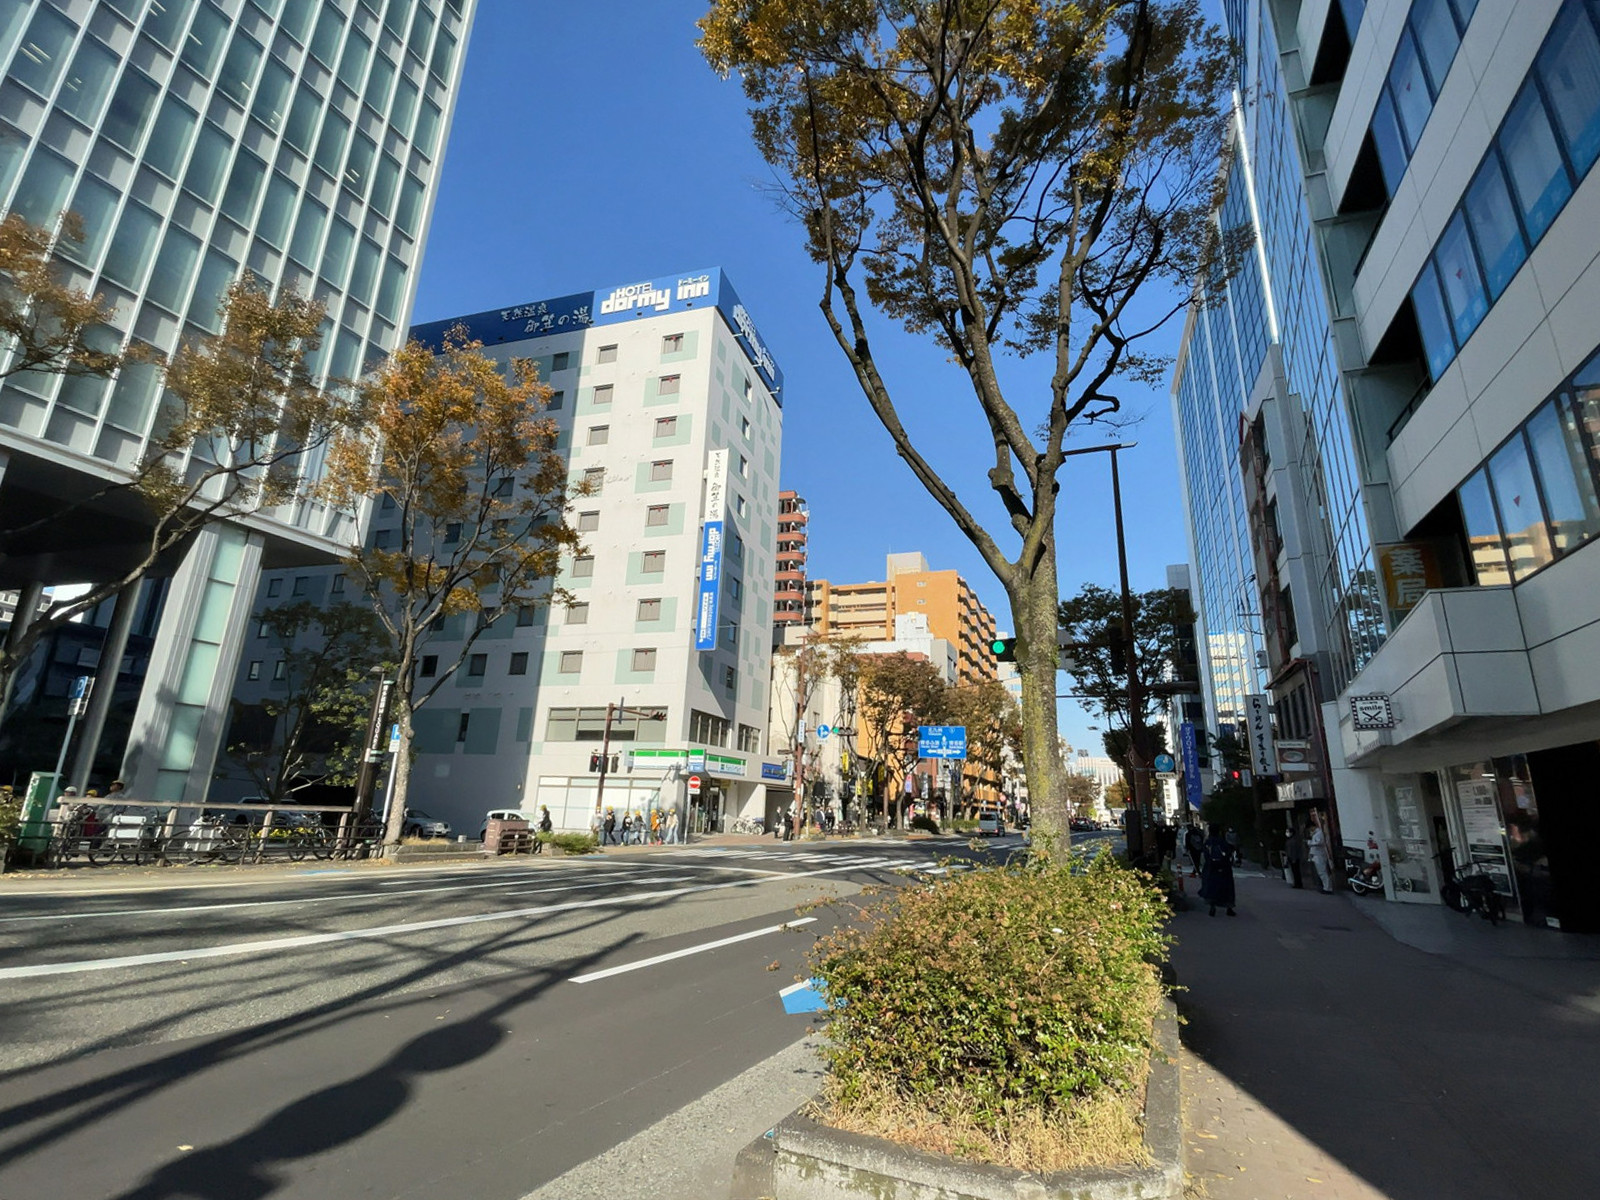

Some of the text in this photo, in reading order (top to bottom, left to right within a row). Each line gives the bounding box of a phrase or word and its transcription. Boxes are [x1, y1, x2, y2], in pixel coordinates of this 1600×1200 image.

[601, 281, 710, 315] dormy inn
[616, 282, 652, 299] HOTEL
[703, 527, 719, 562] dormy
